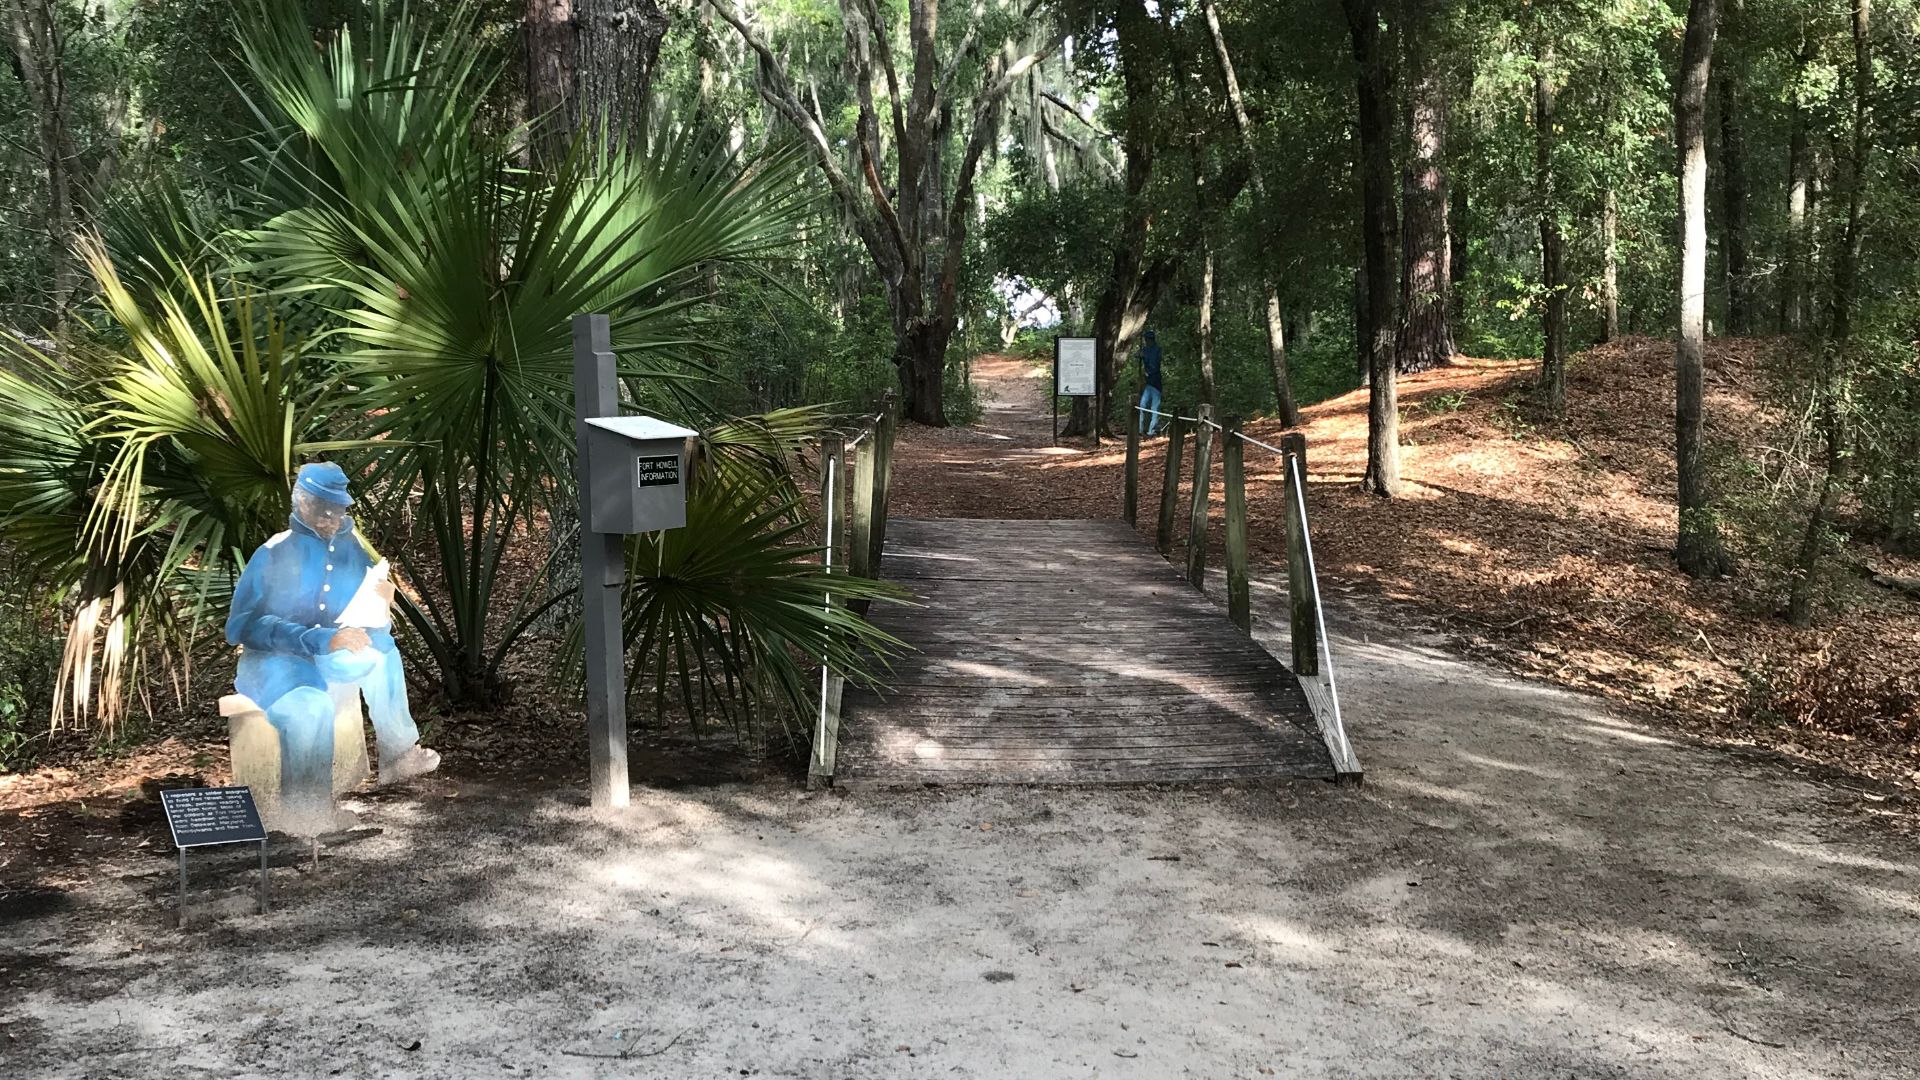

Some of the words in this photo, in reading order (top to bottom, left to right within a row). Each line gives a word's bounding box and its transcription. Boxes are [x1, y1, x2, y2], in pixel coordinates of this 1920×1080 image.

[639, 462, 653, 470] FORT
[656, 461, 678, 469] HOWELL
[640, 470, 677, 480] INFORMATION
